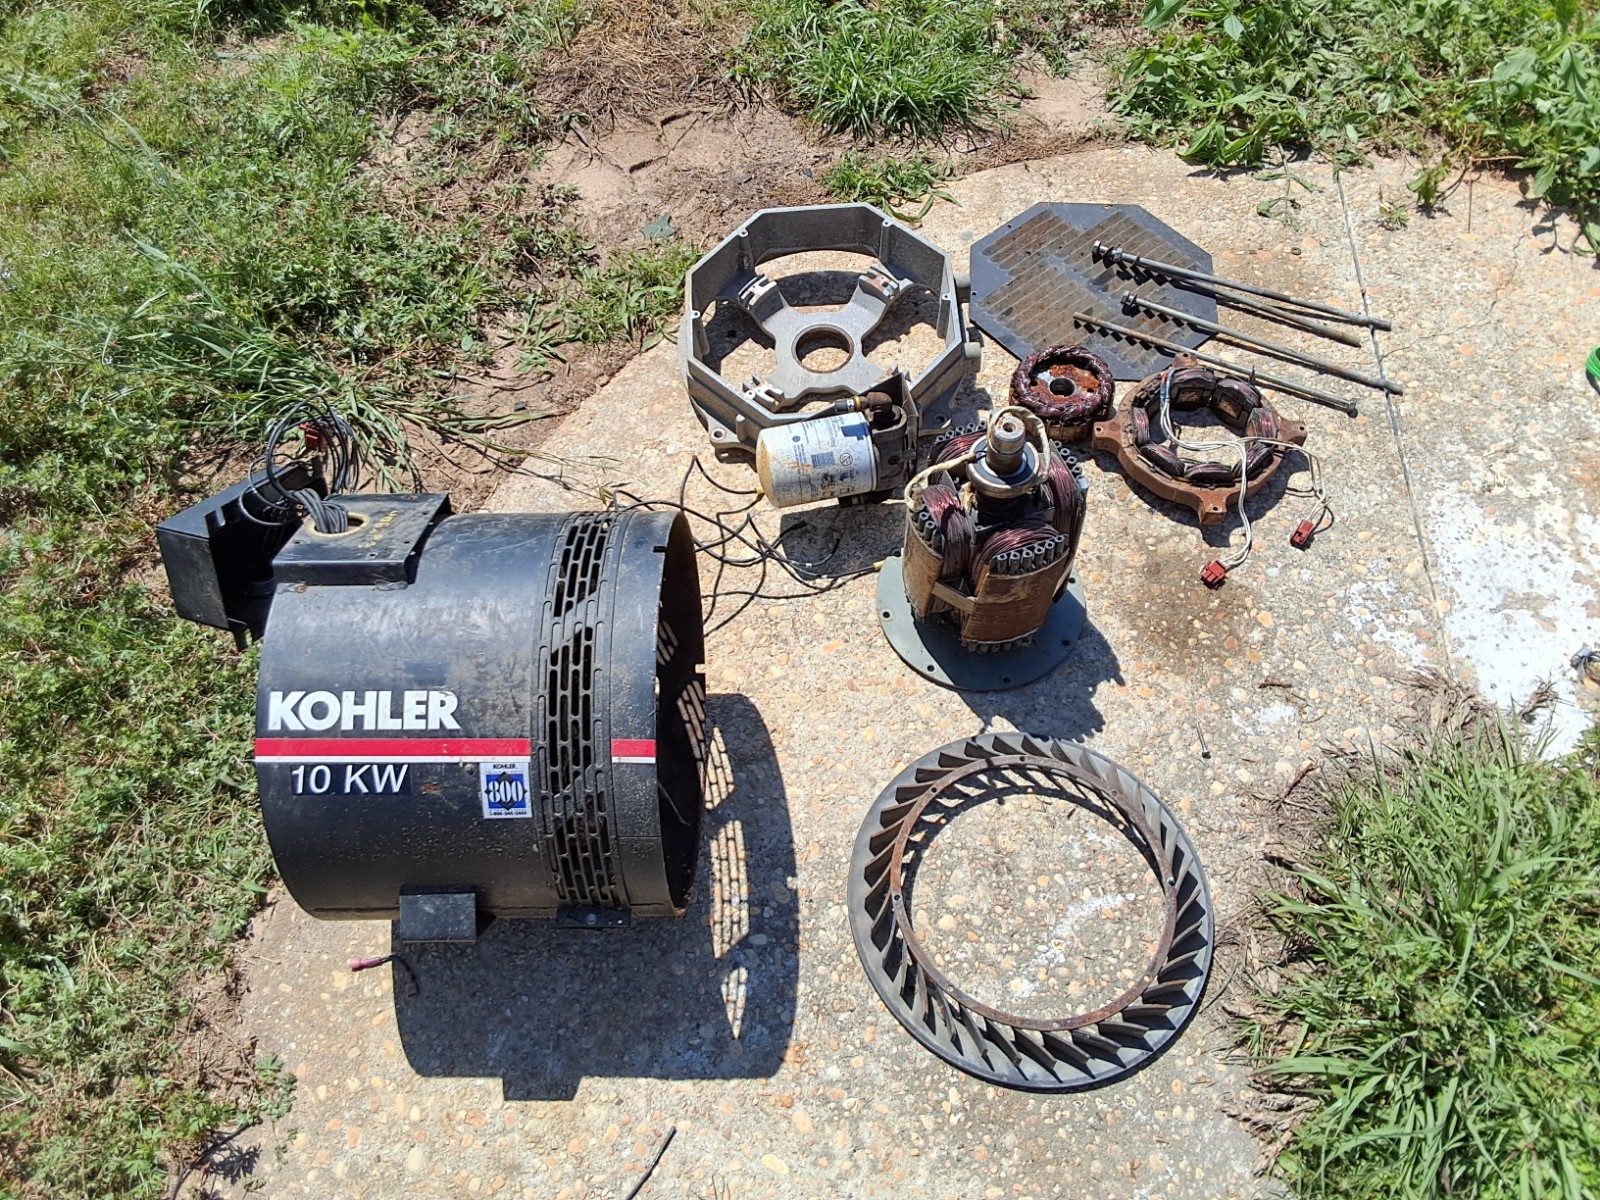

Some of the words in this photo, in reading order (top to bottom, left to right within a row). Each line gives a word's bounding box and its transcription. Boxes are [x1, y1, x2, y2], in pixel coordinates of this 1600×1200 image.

[268, 690, 461, 731] KOHLER
[291, 765, 331, 794] 10
[344, 764, 408, 794] KW
[488, 780, 524, 803] 800
